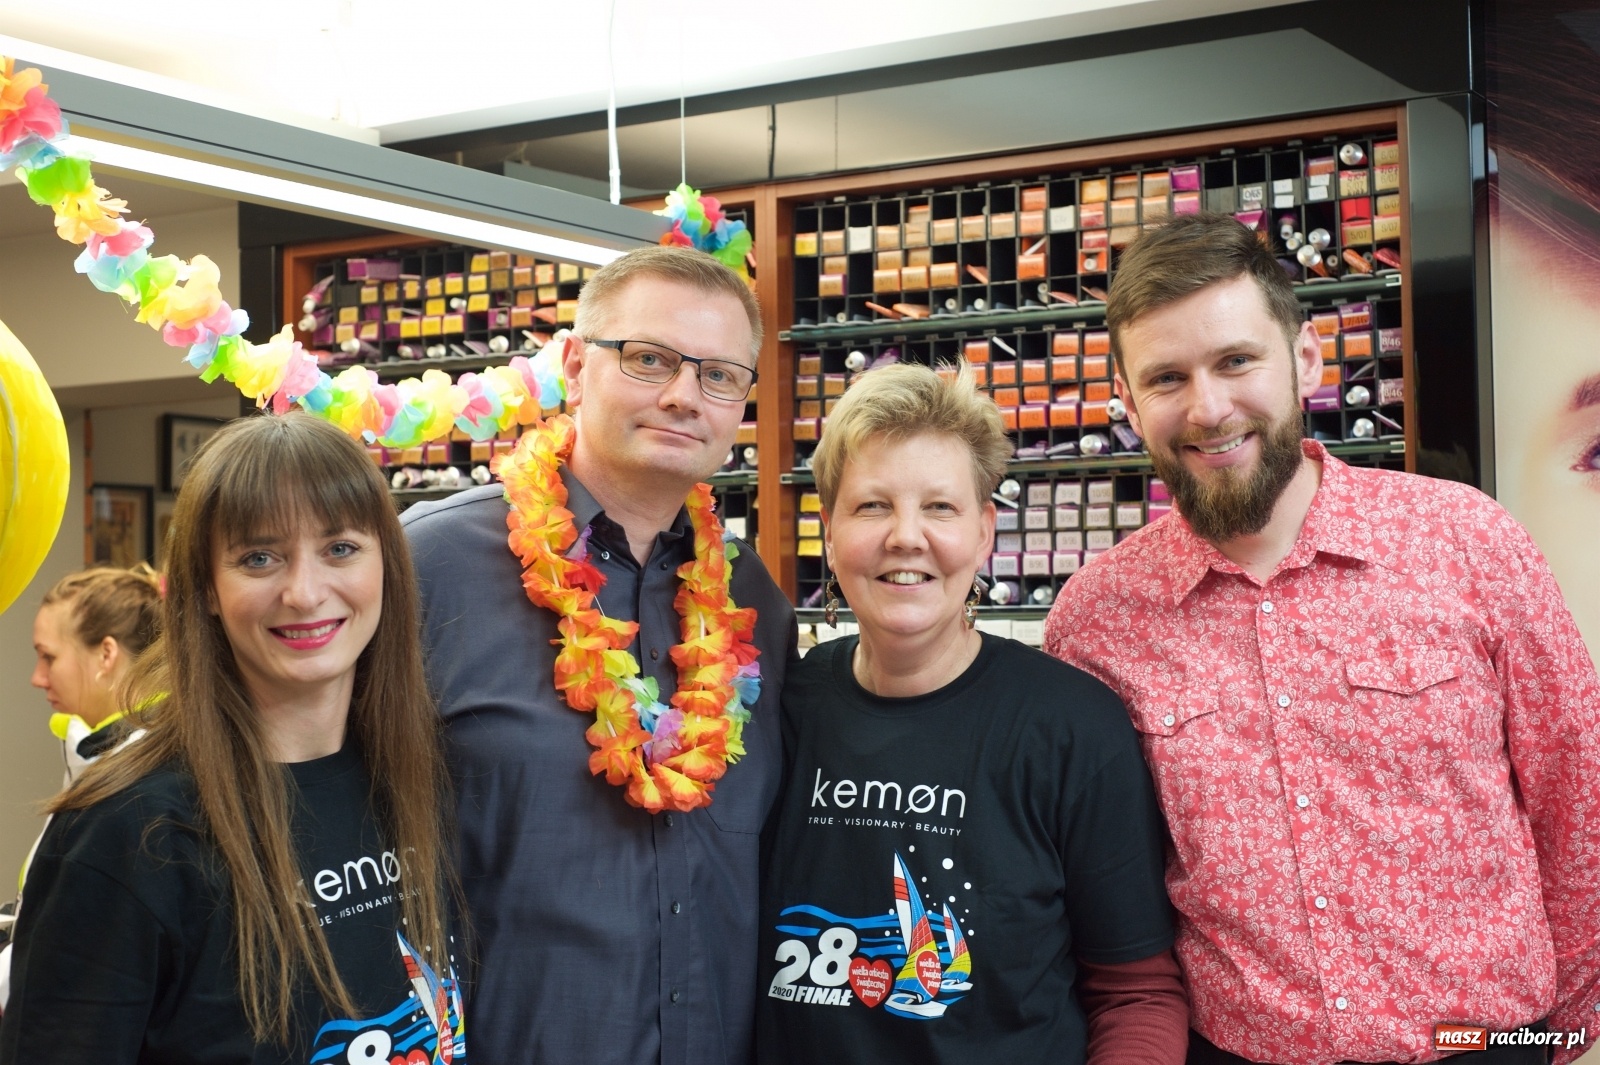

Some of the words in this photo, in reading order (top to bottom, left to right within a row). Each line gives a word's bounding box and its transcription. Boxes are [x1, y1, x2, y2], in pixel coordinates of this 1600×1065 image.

[1382, 337, 1401, 347] 8/46
[1384, 388, 1403, 398] 8/46
[808, 816, 835, 825] TRUE
[845, 817, 906, 829] VISIONARY
[915, 822, 962, 837] BEAUTY
[768, 926, 858, 1001] 28
[772, 985, 793, 998] 2020
[795, 985, 854, 1007] FINAŁ
